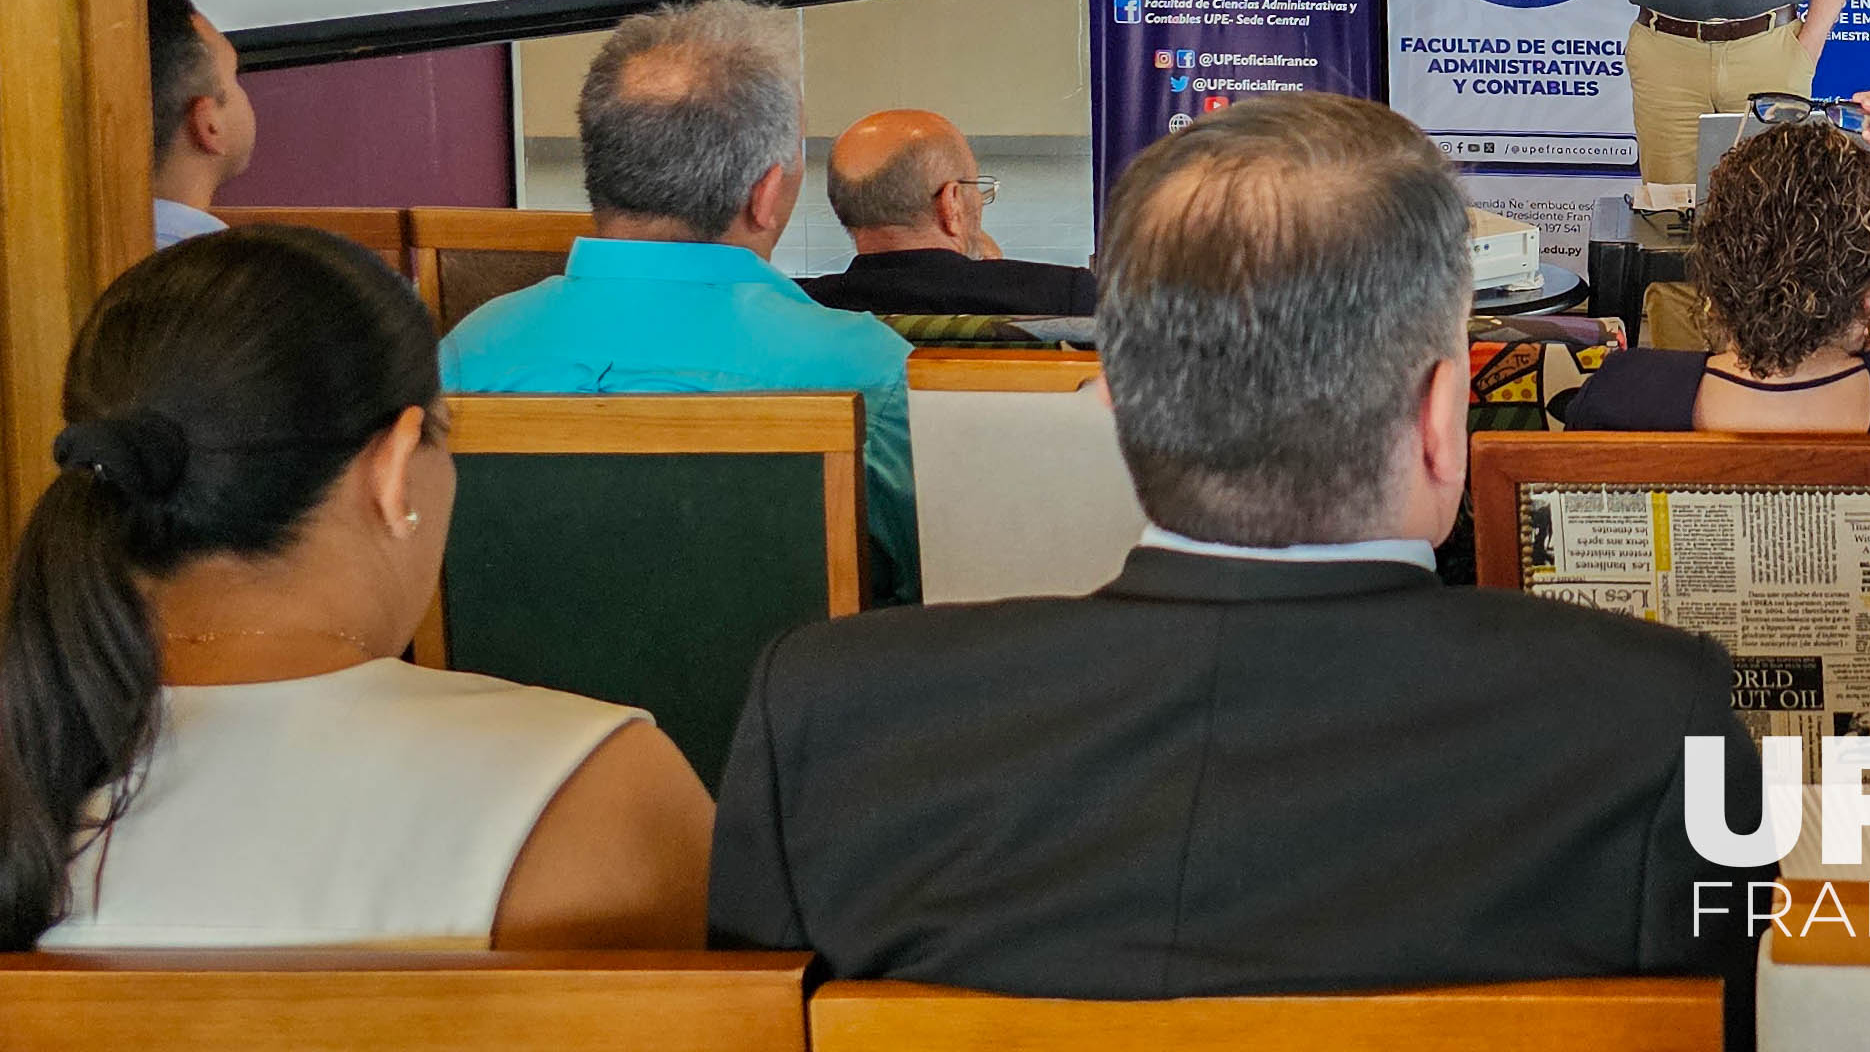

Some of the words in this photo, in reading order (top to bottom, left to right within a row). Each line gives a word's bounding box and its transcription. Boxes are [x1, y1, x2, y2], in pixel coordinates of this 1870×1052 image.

[1195, 0, 1209, 9] de
[1262, 0, 1347, 12] Administrativas
[1350, 3, 1357, 14] y
[1144, 13, 1201, 24] Contables
[1204, 14, 1234, 25] UPE-
[1236, 15, 1264, 26] Sede
[1267, 15, 1310, 26] Central
[1400, 37, 1511, 54] FACULTAD
[1517, 39, 1545, 55] DE
[1551, 40, 1626, 56] CIENCI
[1199, 54, 1318, 68] @UPEoficialfranco
[1427, 58, 1624, 77] ADMINISTRATIVAS
[1192, 77, 1303, 92] @UPEoficialfranc
[1453, 79, 1468, 94] Y
[1472, 79, 1599, 96] CONTABLES
[1506, 211, 1564, 222] Presidente
[1567, 212, 1591, 221] Fran
[1540, 245, 1582, 257] .edu.py
[1605, 589, 1649, 608] Les
[1732, 669, 1793, 688] ORLD
[1780, 690, 1823, 709] OIL
